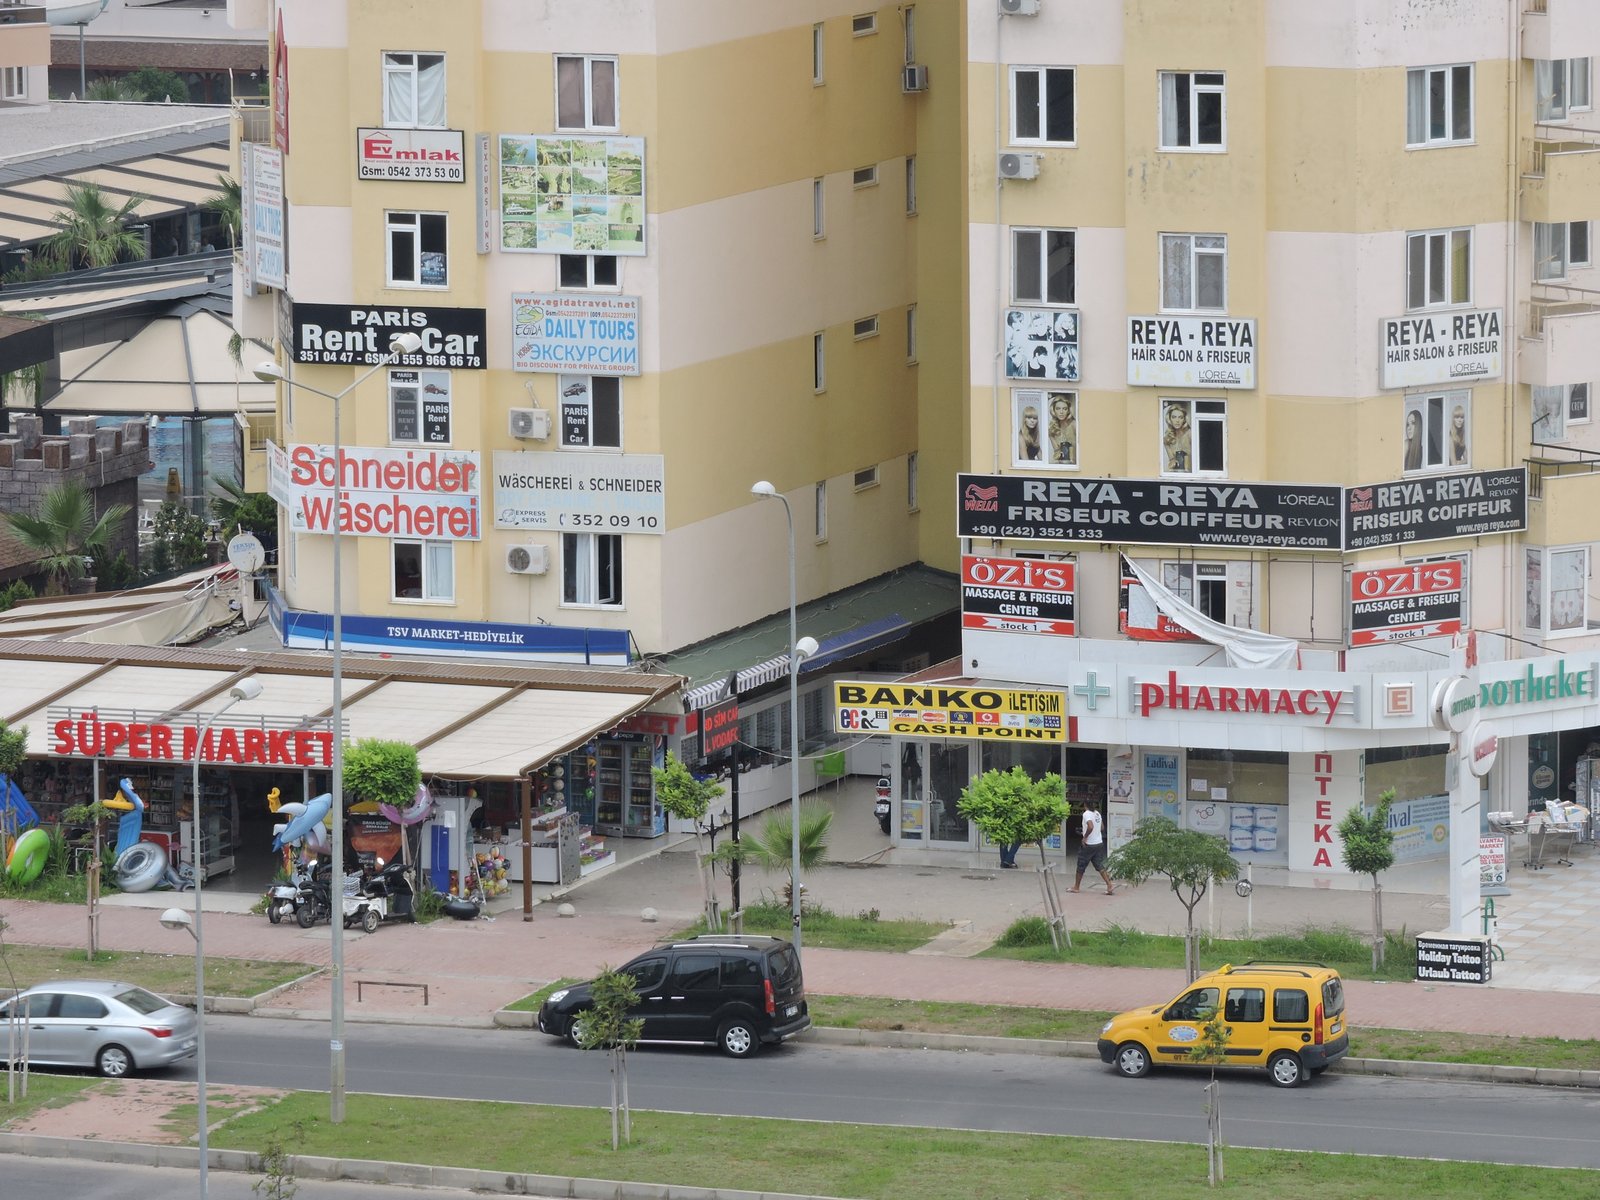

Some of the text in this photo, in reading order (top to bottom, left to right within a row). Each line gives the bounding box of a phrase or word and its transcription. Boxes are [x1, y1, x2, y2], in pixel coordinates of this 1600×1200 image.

[362, 166, 460, 178] Gsm: 0542 373 53 00
[514, 298, 636, 308] www.egidatravel.net
[351, 309, 428, 327] PARİS
[545, 319, 635, 340] DAILY TOURS
[1131, 320, 1182, 345] REYA
[1201, 322, 1253, 347] REYA
[1387, 319, 1435, 347] REYA
[1453, 312, 1500, 340] REYA
[302, 324, 378, 352] Rent
[421, 328, 479, 355] Car
[530, 344, 636, 363] ЭКСКУРСИИ
[1160, 349, 1193, 362] SALON
[1197, 350, 1203, 362] &
[1207, 351, 1251, 364] FRISEUR
[1413, 346, 1444, 360] SALON
[1448, 345, 1454, 357] &
[1458, 341, 1497, 356] FRISEUR
[300, 351, 320, 362] 351
[323, 352, 338, 362] 04
[340, 352, 353, 363] 47
[402, 353, 423, 365] 555
[426, 355, 446, 366] 966
[450, 355, 463, 366] 86
[467, 356, 480, 367] 78
[1571, 402, 1584, 411] CREW
[428, 414, 447, 423] Rent
[567, 416, 586, 425] Rent
[430, 433, 445, 441] Car
[570, 435, 584, 443] Car
[291, 446, 476, 492] Schneider
[579, 481, 585, 490] &
[590, 478, 662, 493] SCHNEIDER
[1378, 477, 1485, 508] REYA REYA
[1489, 488, 1519, 497] REVLON
[1023, 481, 1121, 504] REYA
[1159, 485, 1258, 508] REYA
[965, 500, 998, 512] WELLA
[301, 492, 477, 537] Wäscherei
[572, 514, 657, 528] 352 09 10
[1008, 506, 1285, 530] FRISEUR COIFFEUR
[1288, 517, 1339, 527] REVLON
[1353, 498, 1512, 531] FRISEUR COIFFEUR
[972, 525, 997, 534] +90
[1000, 526, 1035, 538] (242)
[1078, 529, 1103, 538] 333
[1351, 530, 1416, 547] +90 (242) 352 1 333
[1199, 533, 1328, 547] www.reya-reya.com
[965, 587, 1016, 600] MASSAGE
[1019, 592, 1027, 602] &
[999, 604, 1039, 616] CENTER
[1355, 599, 1404, 614] MASSAGE
[1407, 599, 1415, 608] &
[1388, 611, 1426, 624] CENTER
[387, 626, 524, 644] TSV MARKET-HEDİYELİK
[1389, 631, 1415, 640] stock
[839, 686, 1002, 710] BANKO
[894, 723, 1062, 739] CASH POINT
[54, 713, 334, 766] SÜPER MARKET
[1146, 757, 1176, 769] Ladival
[1418, 941, 1481, 952] Временная татуировка
[1418, 950, 1481, 965] Holiday Tattoo
[1418, 966, 1481, 980] Urlaub Tattoo
